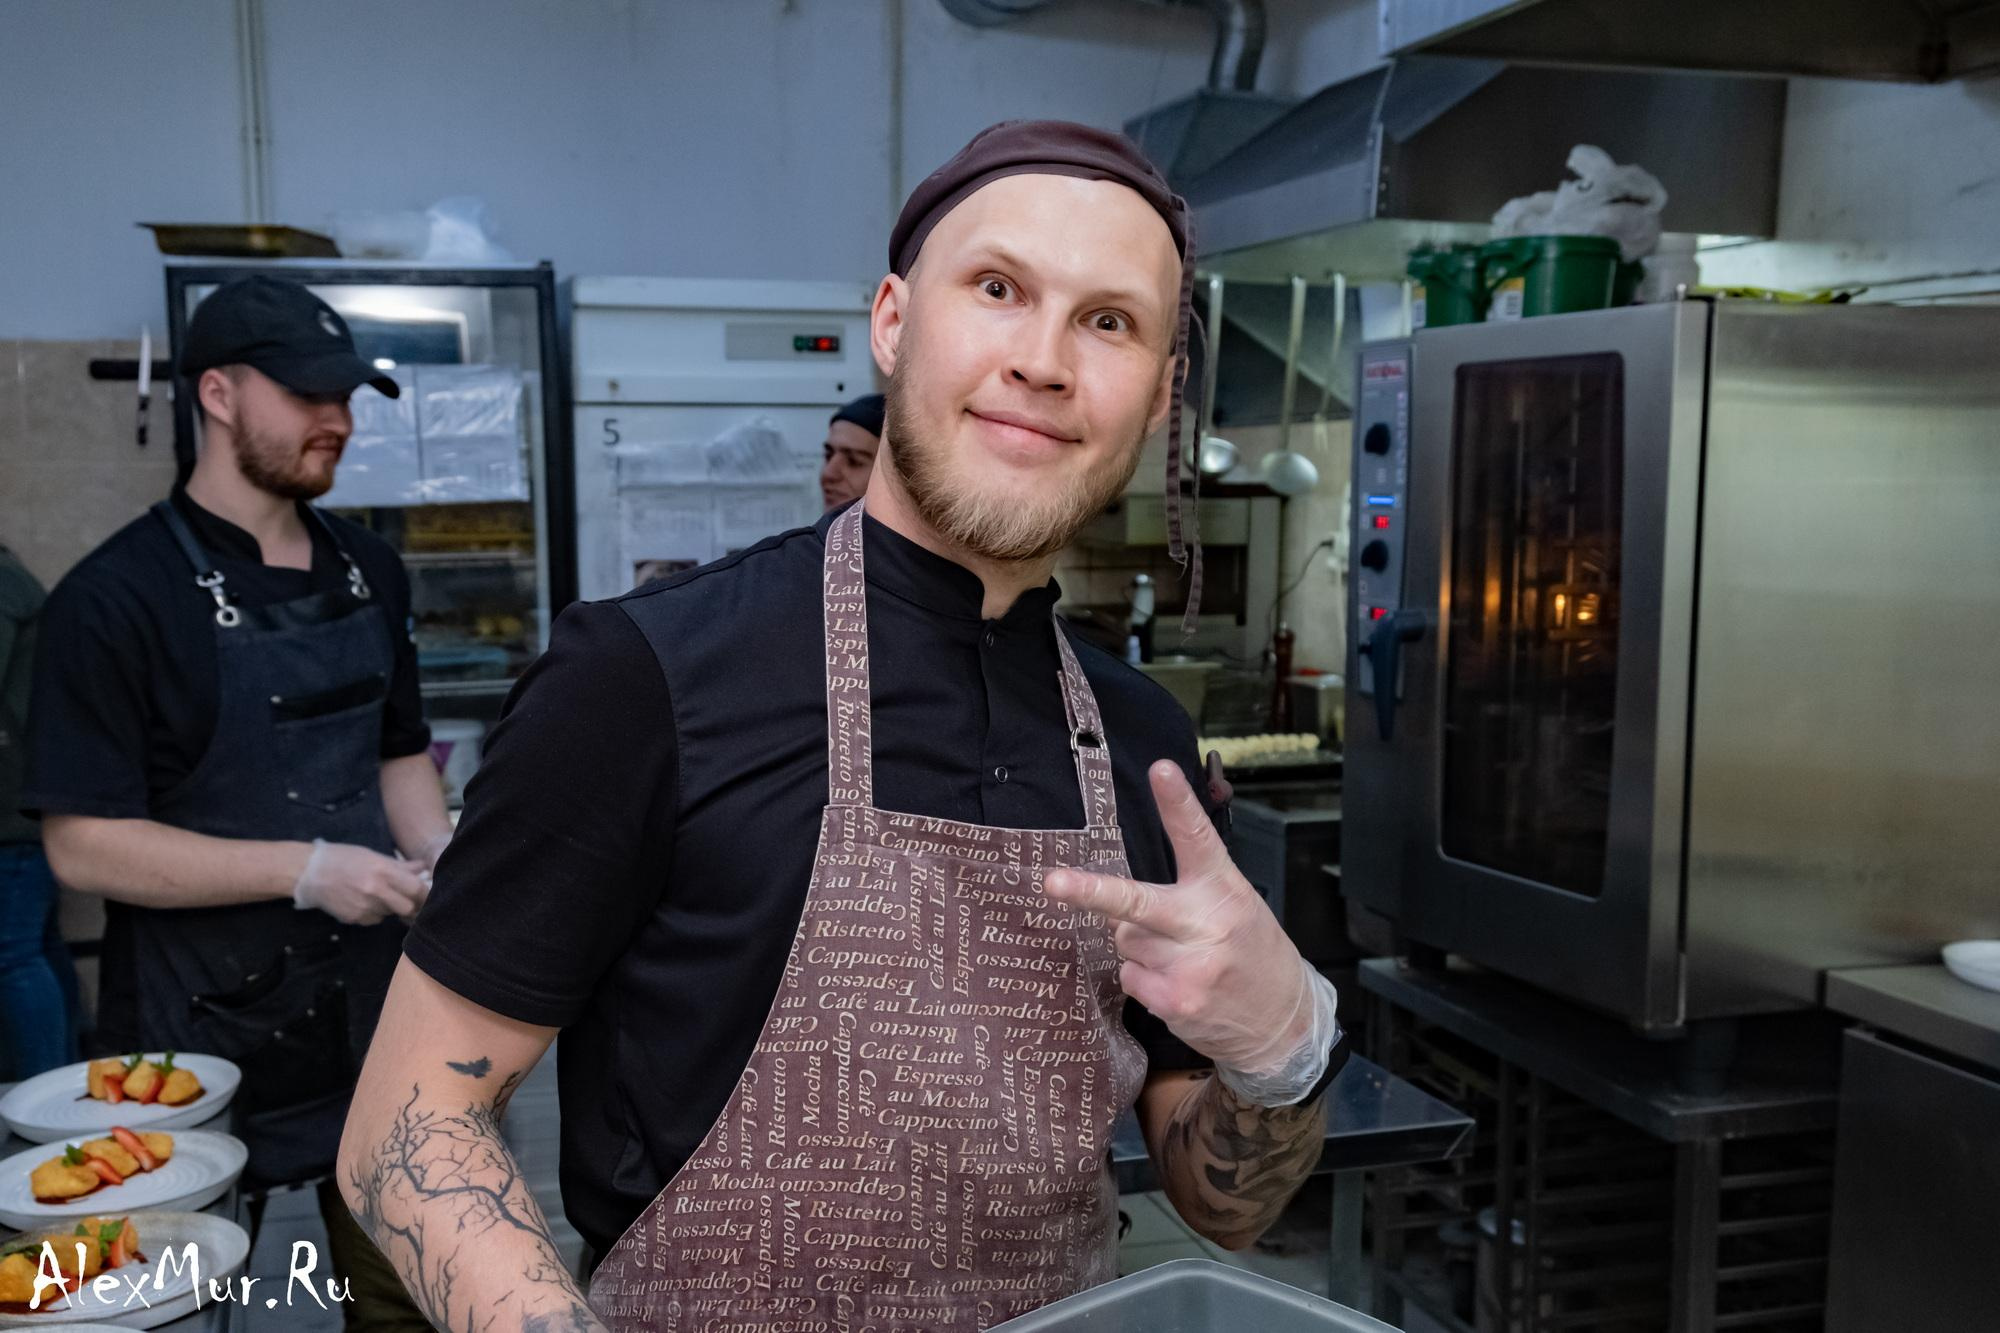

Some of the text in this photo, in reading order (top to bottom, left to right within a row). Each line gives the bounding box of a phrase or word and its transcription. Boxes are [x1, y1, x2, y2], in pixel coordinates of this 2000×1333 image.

[603, 418, 620, 447] 5
[837, 696, 855, 783] Ristretto
[889, 815, 914, 828] au
[920, 816, 991, 842] Mocha
[880, 831, 1000, 862] Cappuccino
[953, 865, 998, 886] Lait
[1003, 840, 1021, 886] Café
[825, 876, 851, 889] au
[856, 871, 898, 893] Lait
[910, 861, 928, 951] Ristretto
[953, 881, 1049, 910] Espresso
[928, 864, 946, 990] Café au Lait
[983, 909, 1010, 923] au
[812, 919, 907, 942] Ristretto
[980, 925, 1072, 951] Ristretto
[807, 946, 930, 970] Cappuccino
[953, 904, 974, 998] Espresso
[976, 952, 1073, 979] Espresso
[817, 972, 917, 997] Espresso
[987, 976, 1062, 1000] Mocha
[780, 991, 947, 1017] au Café au Lait
[950, 1003, 1069, 1027] Cappuccino
[771, 1015, 819, 1034] Café
[868, 1021, 958, 1045] Ristretto
[1004, 1026, 1049, 1045] Lait
[1052, 1028, 1078, 1041] au
[858, 1041, 964, 1065] Café Latte
[974, 1023, 992, 1070] Café
[833, 1010, 857, 1134] Cappuccino
[891, 1064, 984, 1090] Espresso
[768, 1057, 787, 1149] Ristretto
[802, 1054, 821, 1129] Mocha
[858, 1068, 877, 1118] Café
[887, 1089, 991, 1109] au Mocha
[1000, 1049, 1020, 1153] Café Latte
[740, 1067, 759, 1171] Café Latte
[877, 1108, 999, 1133] Cappuccino
[1020, 1064, 1041, 1158] Espresso
[1076, 1066, 1096, 1152] Ristretto
[1050, 1073, 1067, 1176] Café Latte
[797, 1131, 897, 1156] Espresso
[957, 1137, 999, 1155] Lait
[765, 1152, 897, 1173] Café au Lait
[956, 1157, 1047, 1181] Espresso
[675, 1171, 777, 1193] au Mocha
[779, 1176, 907, 1202] Cappuccino
[910, 1137, 929, 1232] Ristretto
[987, 1183, 1013, 1196] au
[673, 1196, 755, 1215] Ristretto
[808, 1200, 904, 1223] Ristretto
[929, 1141, 948, 1270] Café au Lait
[985, 1200, 1066, 1217] Ristretto
[672, 1218, 755, 1242] Espresso
[784, 1194, 801, 1269] Mocha
[803, 1226, 931, 1251] Cappuccino
[956, 1180, 978, 1273] Espresso
[980, 1222, 1064, 1243] Espresso
[754, 1195, 777, 1292] Espresso
[681, 1247, 745, 1266] Mocha
[815, 1254, 915, 1279] Espresso
[991, 1247, 1059, 1268] Mocha
[621, 1279, 646, 1296] Lait
[649, 1271, 752, 1295] Cappuccino
[777, 1276, 804, 1290] au
[815, 1273, 947, 1298] Café au Lait
[695, 1295, 818, 1317] Café au Lait
[868, 1304, 959, 1325] Ristretto
